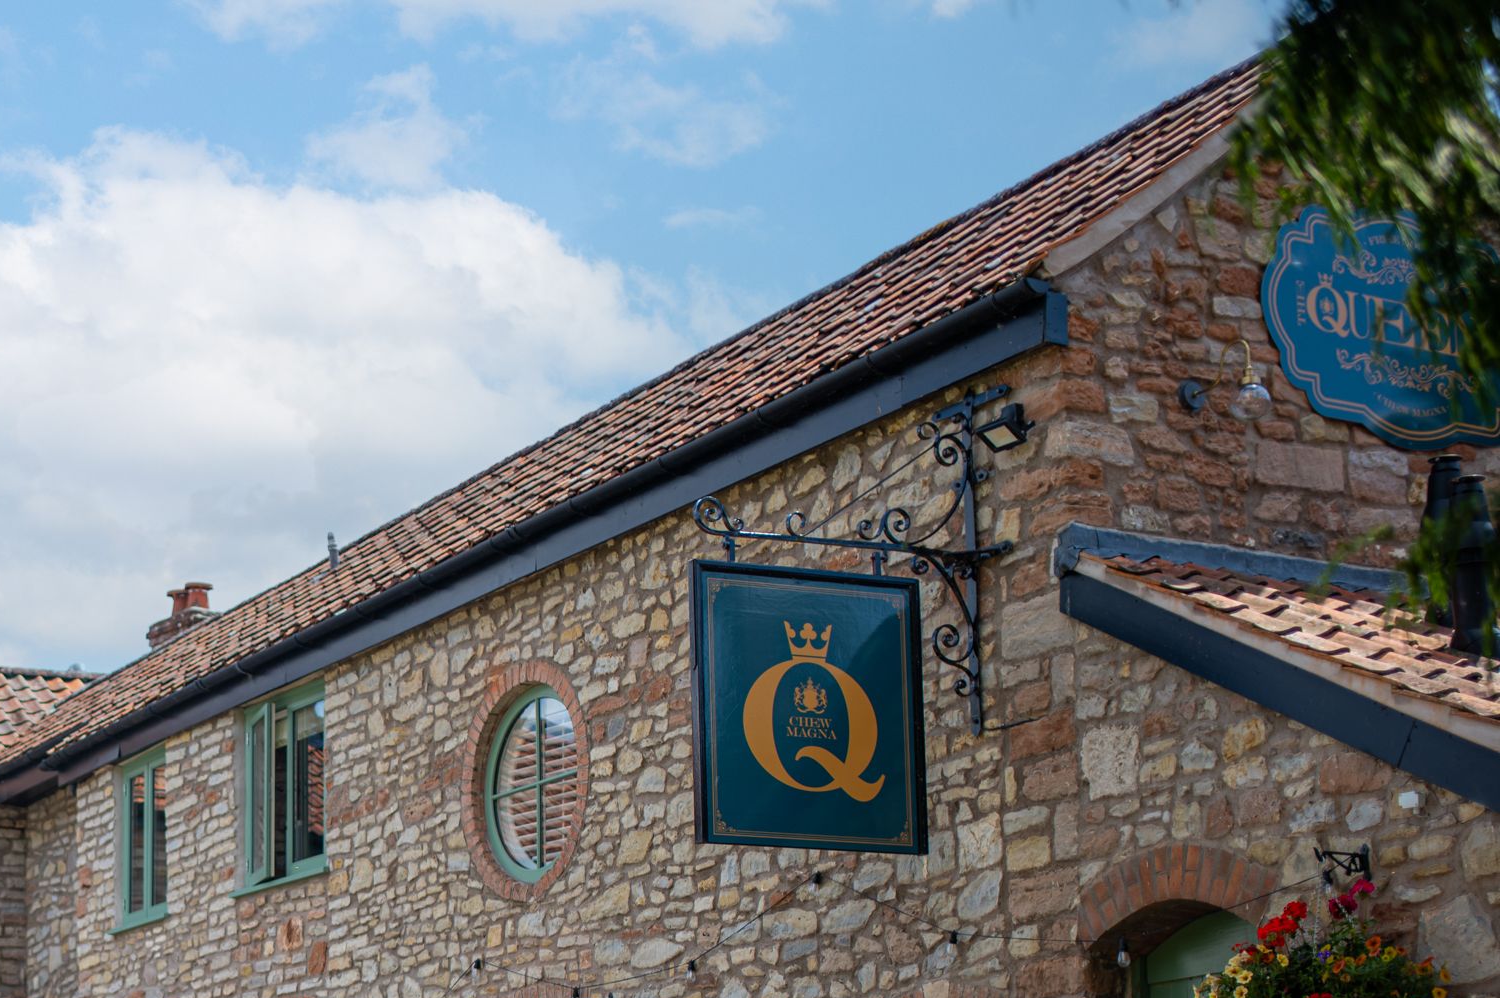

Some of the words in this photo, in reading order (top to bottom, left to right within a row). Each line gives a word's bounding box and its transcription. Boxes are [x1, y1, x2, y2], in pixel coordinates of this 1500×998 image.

[1306, 285, 1465, 357] QUEE
[743, 658, 886, 802] Q
[786, 726, 836, 740] MAGNA
[789, 716, 832, 728] CHEW
